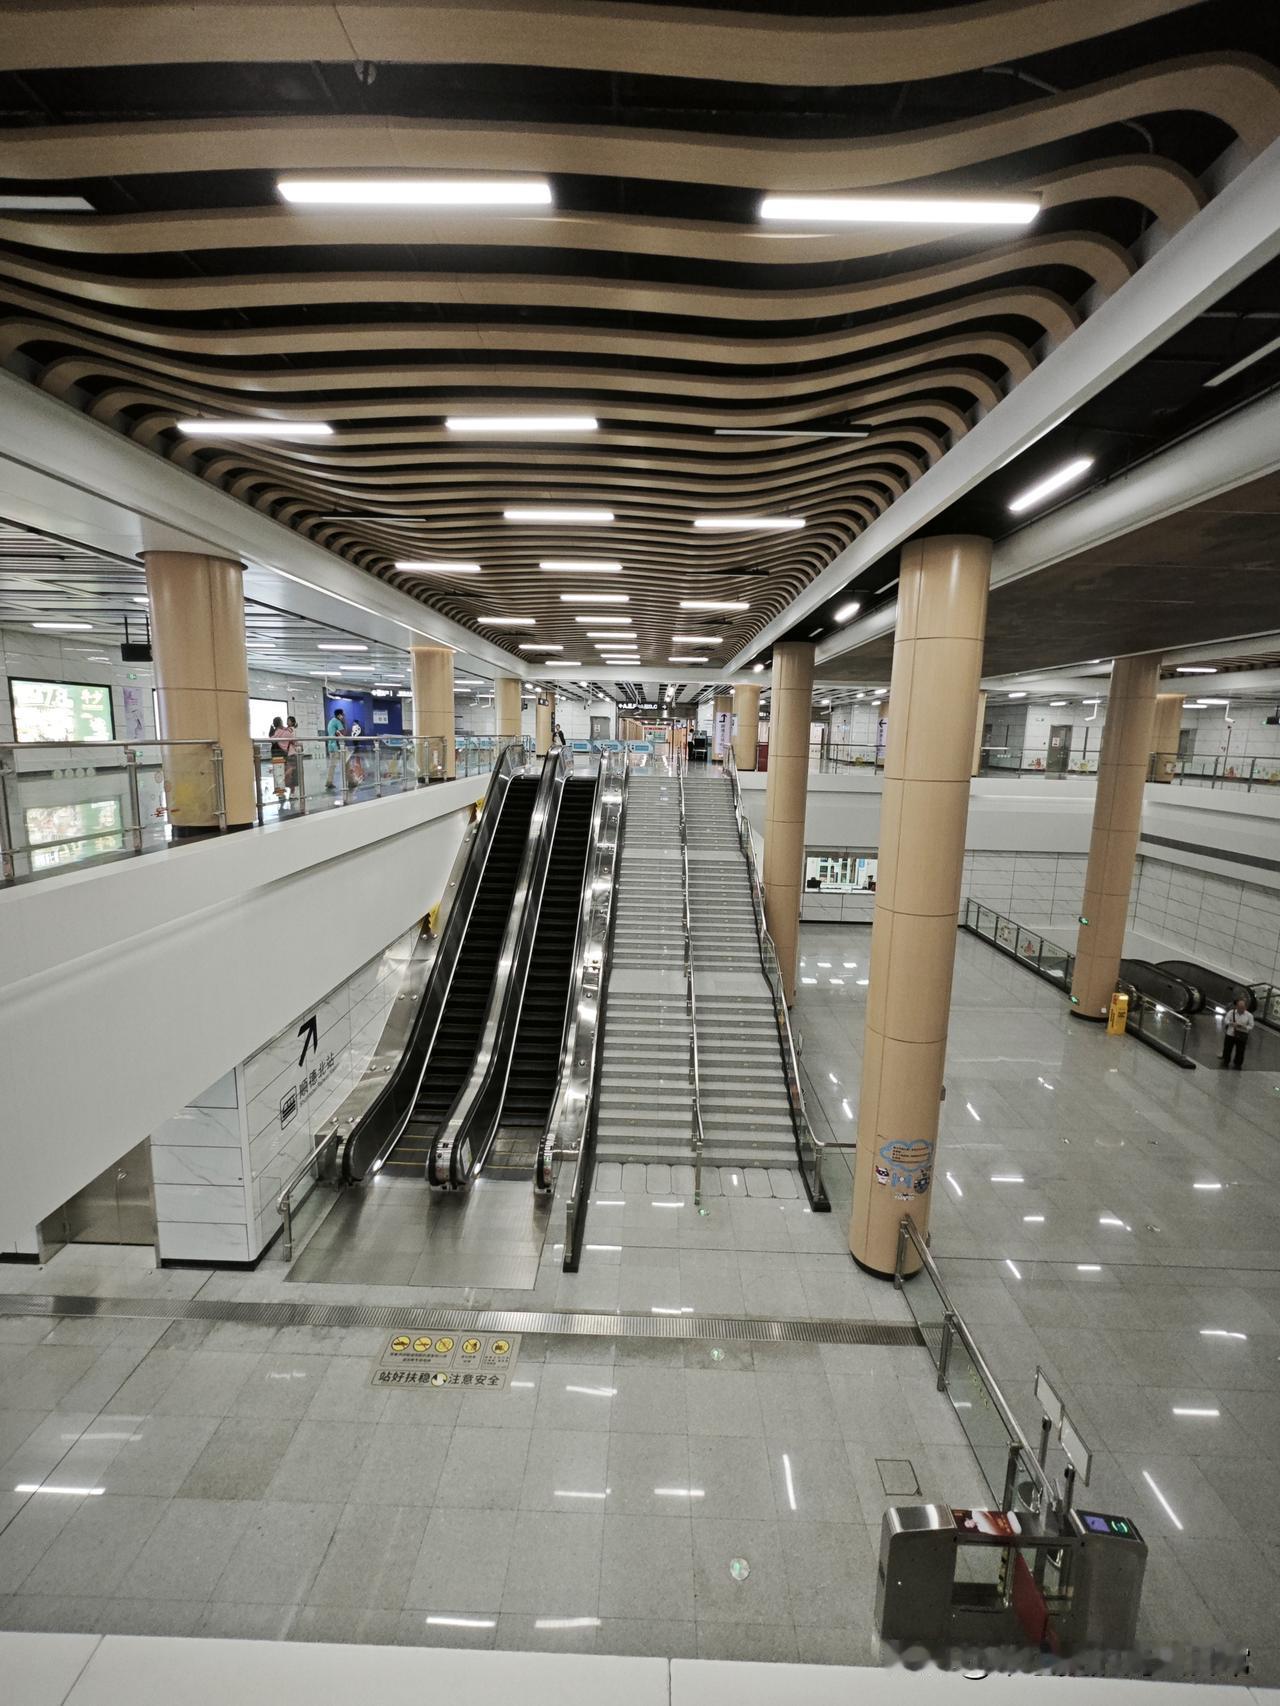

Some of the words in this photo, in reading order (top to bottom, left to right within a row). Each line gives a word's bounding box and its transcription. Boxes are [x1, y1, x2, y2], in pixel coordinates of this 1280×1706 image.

[378, 1371, 431, 1384] 站好扶稳
[448, 1374, 500, 1386] 注意安全
